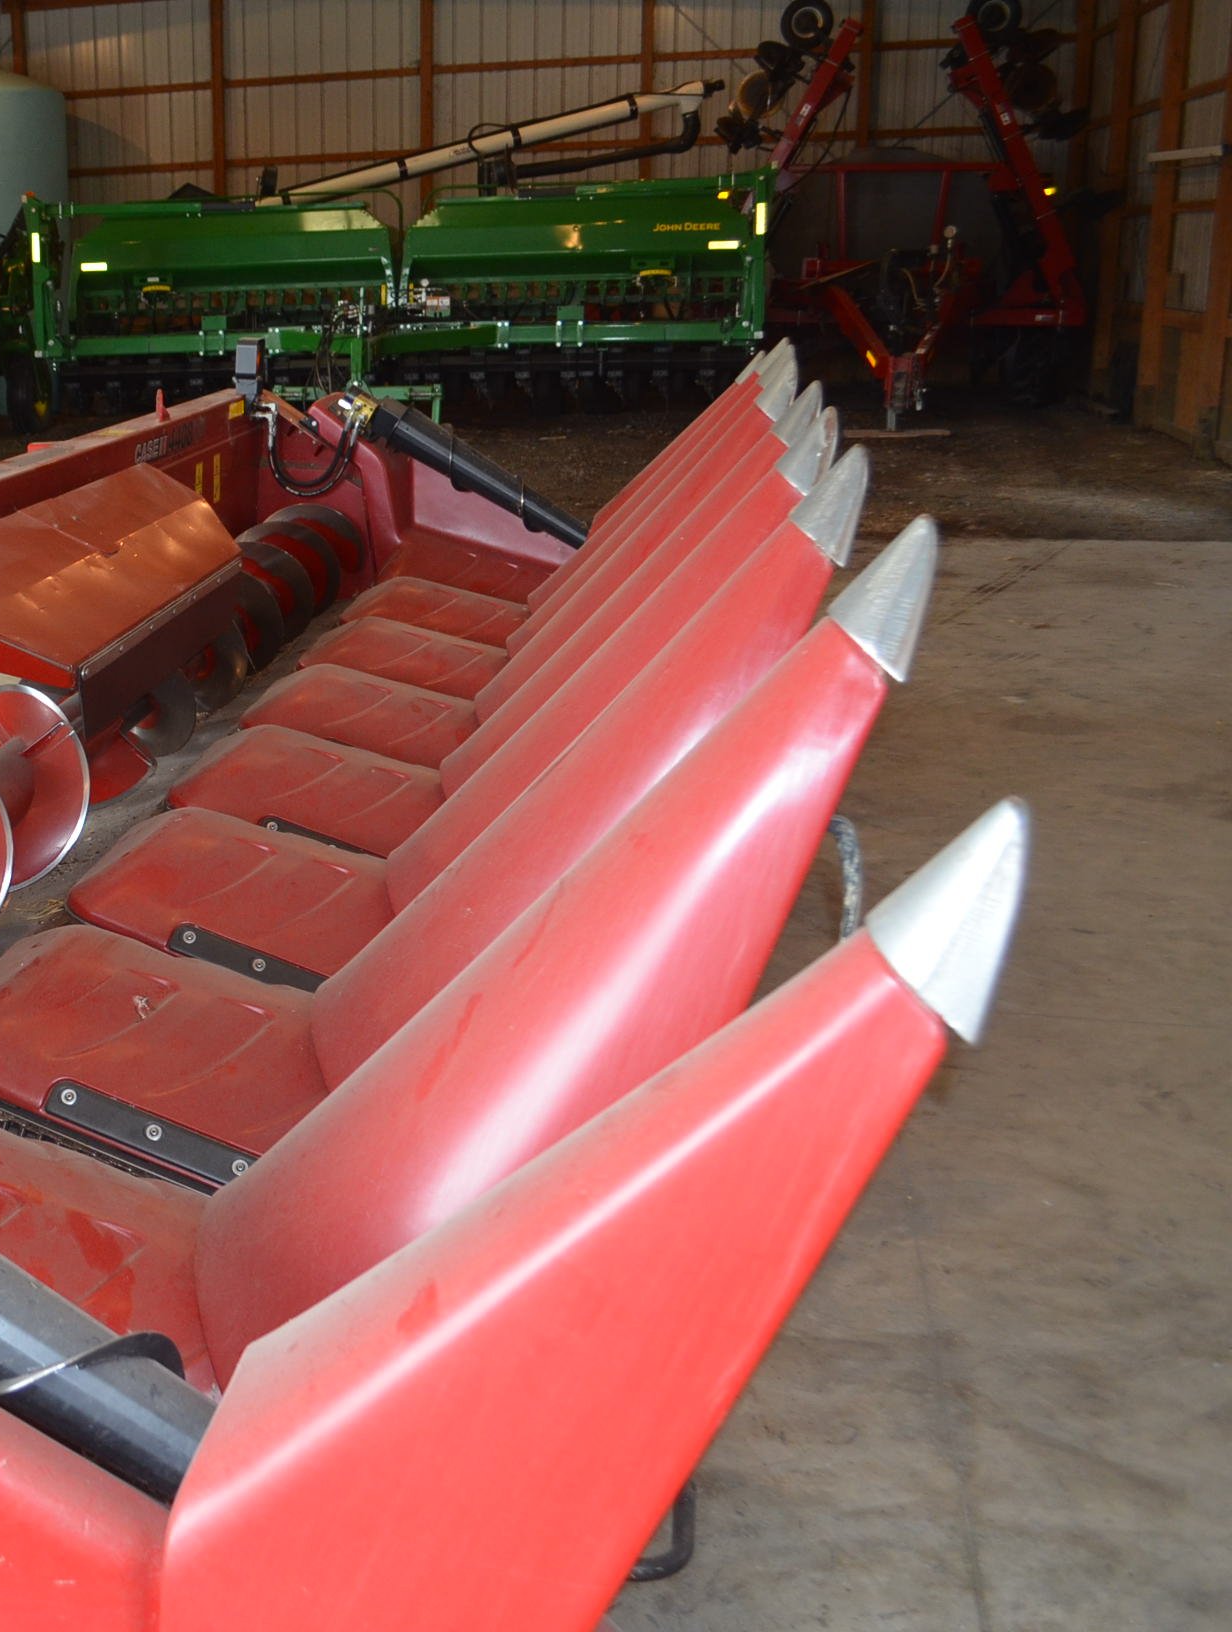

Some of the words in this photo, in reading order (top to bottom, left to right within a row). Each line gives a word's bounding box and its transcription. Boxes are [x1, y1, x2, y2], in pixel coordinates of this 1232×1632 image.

[652, 223, 683, 232] JOHN
[683, 222, 721, 231] DEERE
[134, 437, 159, 464] CASE
